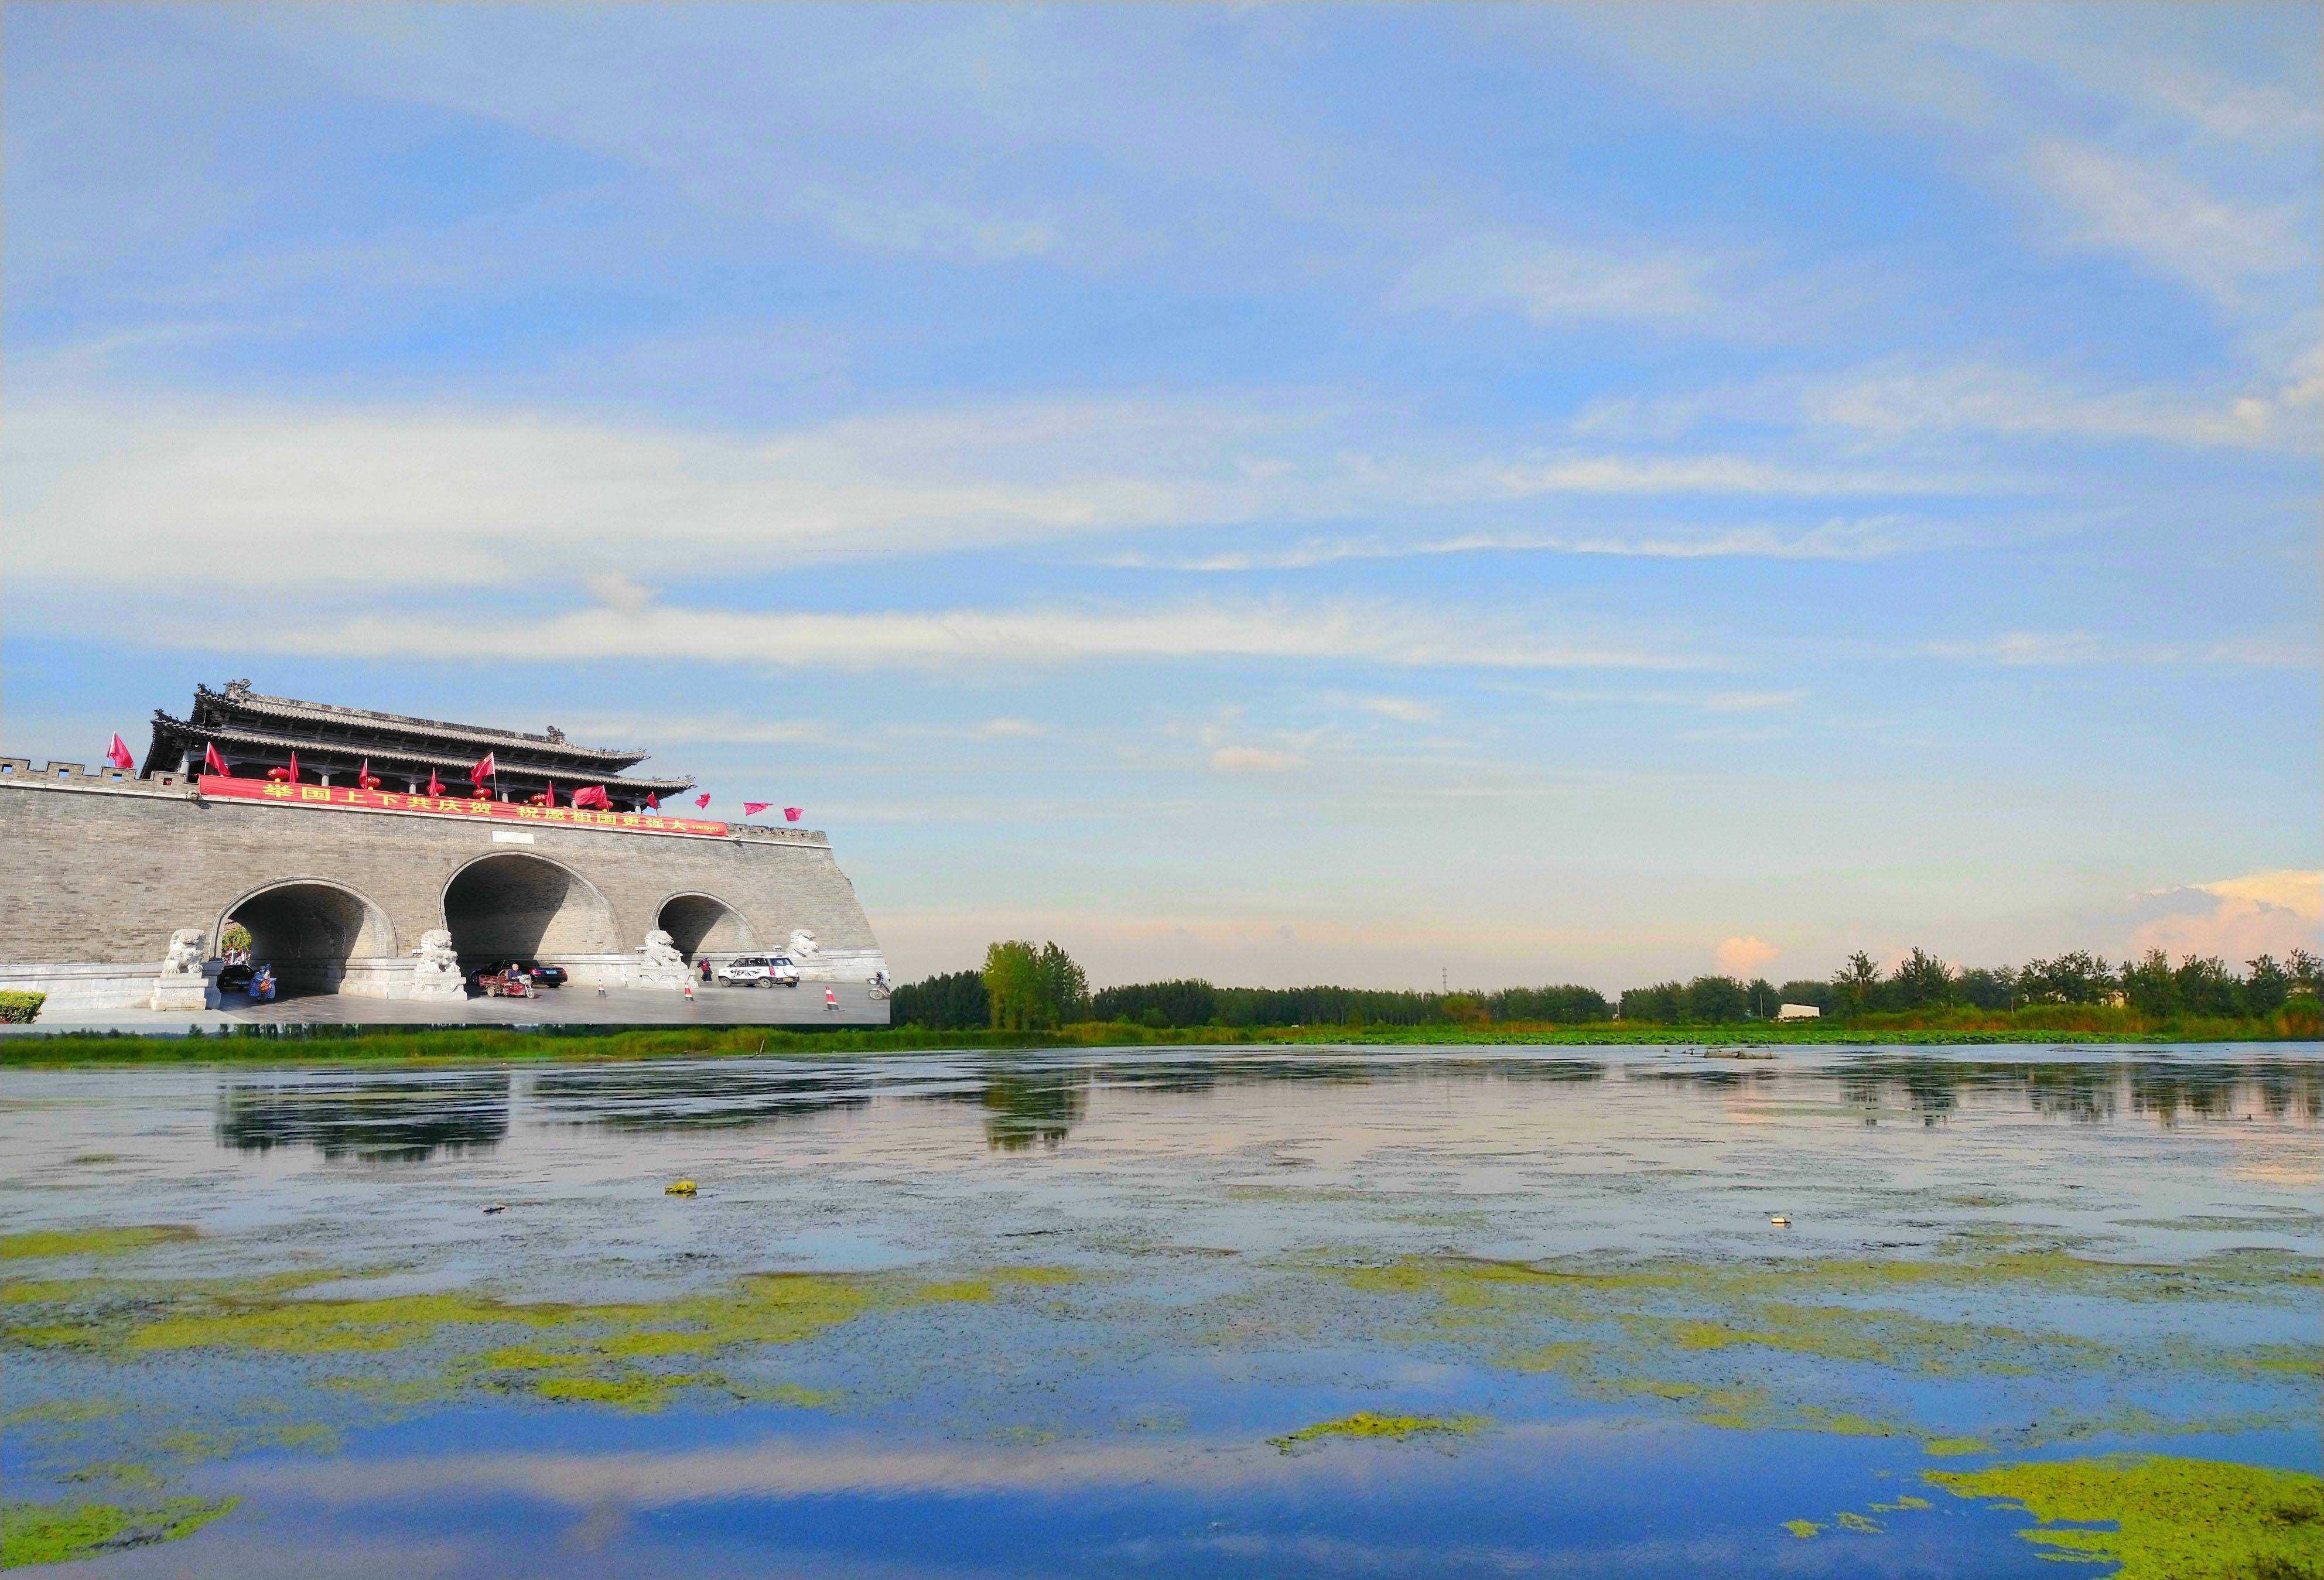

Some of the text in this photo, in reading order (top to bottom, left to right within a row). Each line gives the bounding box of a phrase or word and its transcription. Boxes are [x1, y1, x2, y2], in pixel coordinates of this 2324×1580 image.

[262, 784, 688, 830] 举国上下共庆贺 祝愿祖国更强大
